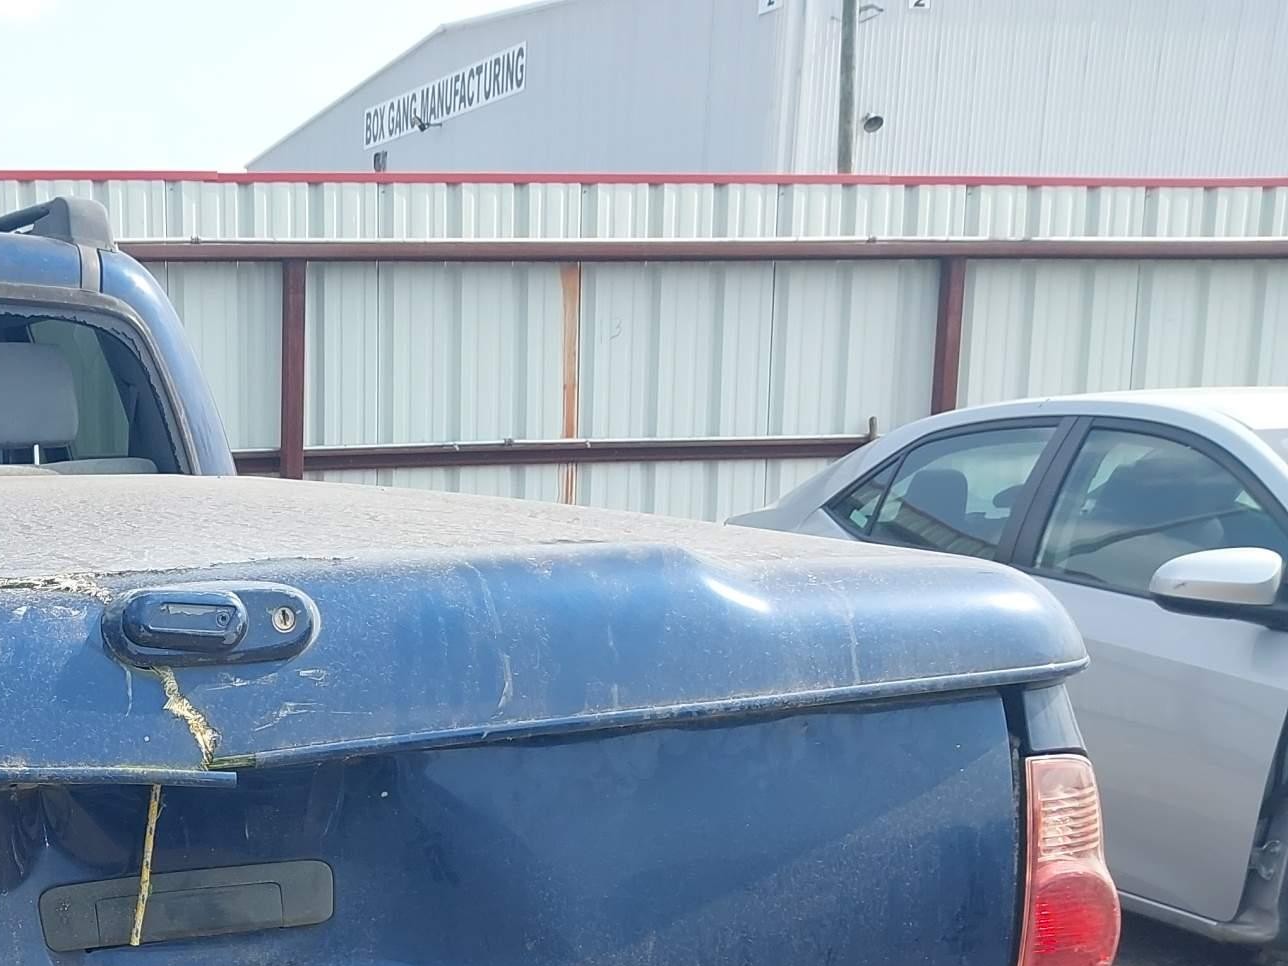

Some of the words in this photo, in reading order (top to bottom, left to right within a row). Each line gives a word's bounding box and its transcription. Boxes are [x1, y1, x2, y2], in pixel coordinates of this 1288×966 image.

[365, 105, 385, 145] BOX
[388, 92, 418, 136] GANG
[420, 47, 524, 126] MANUFACTURING
